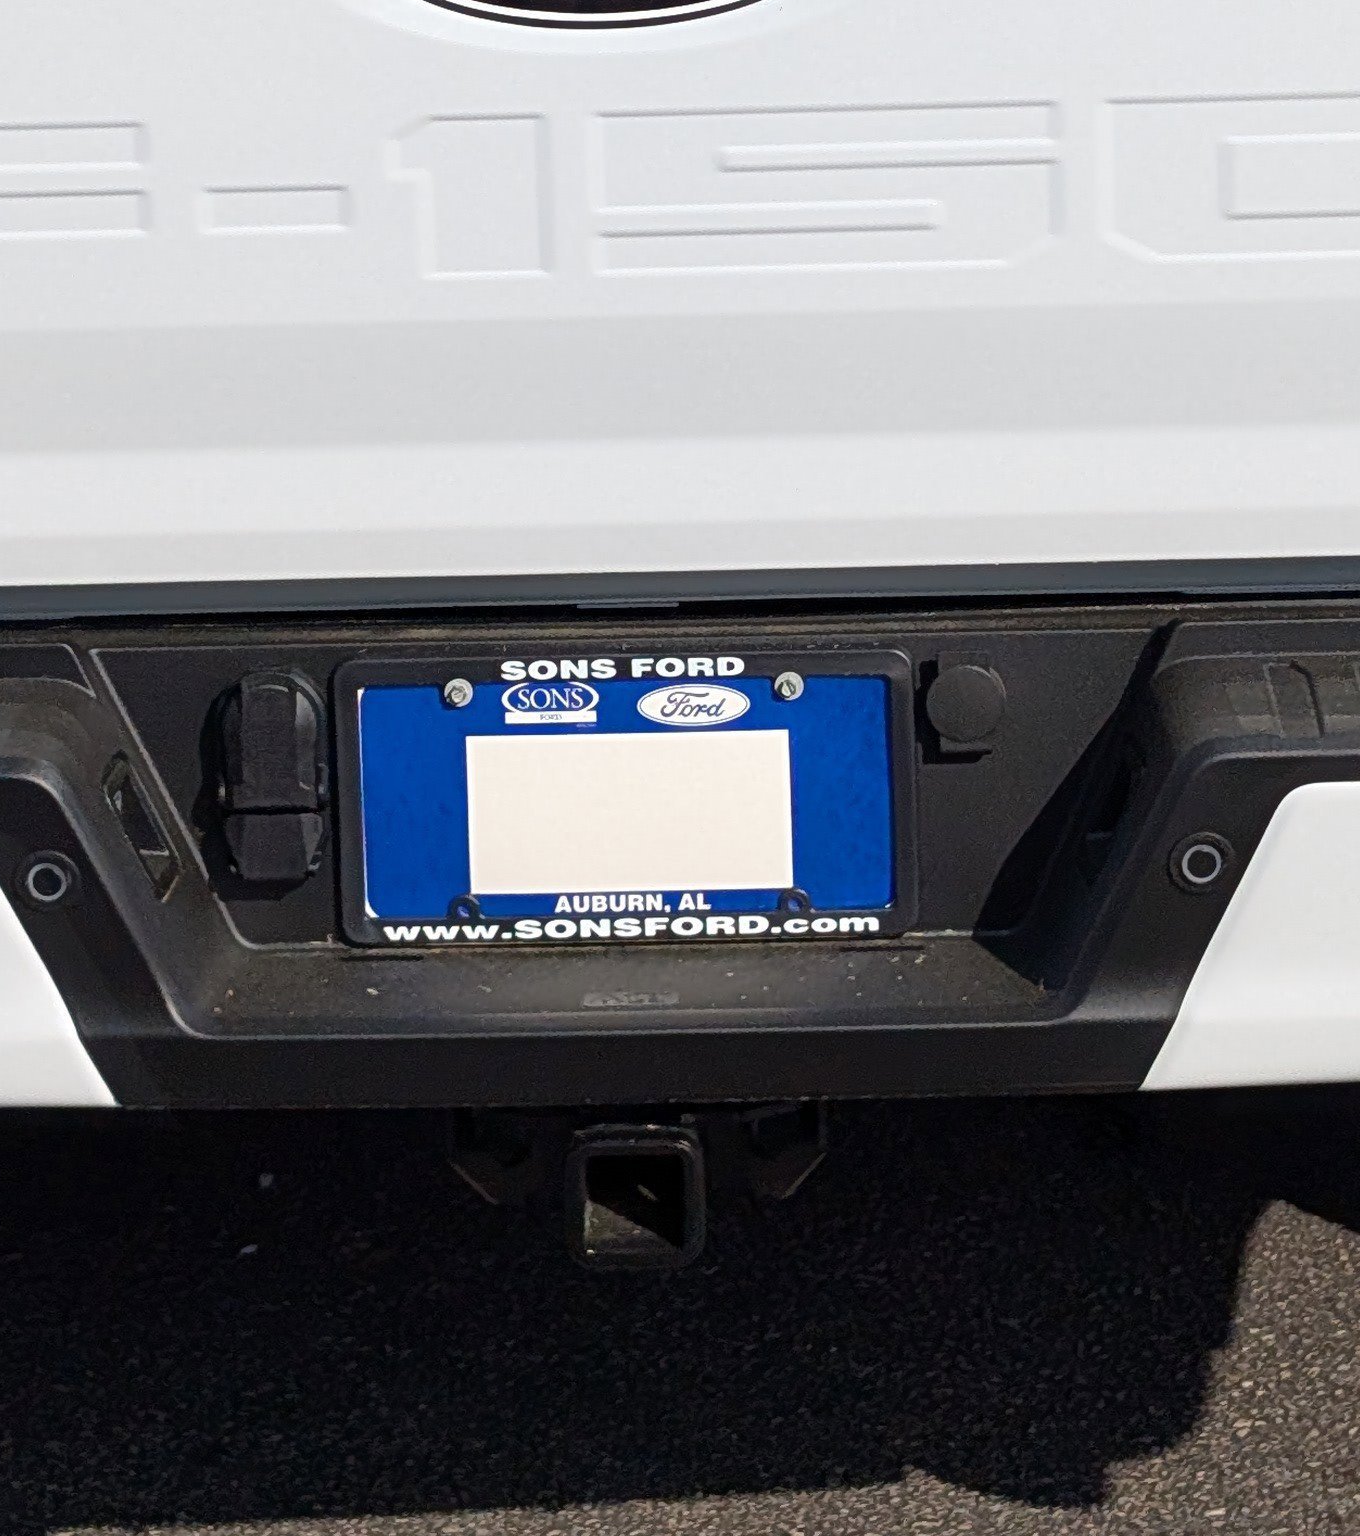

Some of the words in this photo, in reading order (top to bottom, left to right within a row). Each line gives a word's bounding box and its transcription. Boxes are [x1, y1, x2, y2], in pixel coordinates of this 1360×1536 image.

[500, 658, 617, 681] SONS
[631, 656, 746, 678] FORD
[517, 686, 585, 711] SONS
[660, 691, 726, 718] Ford
[554, 894, 671, 914] AUBURN,
[678, 894, 711, 911] AL
[383, 914, 881, 941] www.SONSFORD.com
